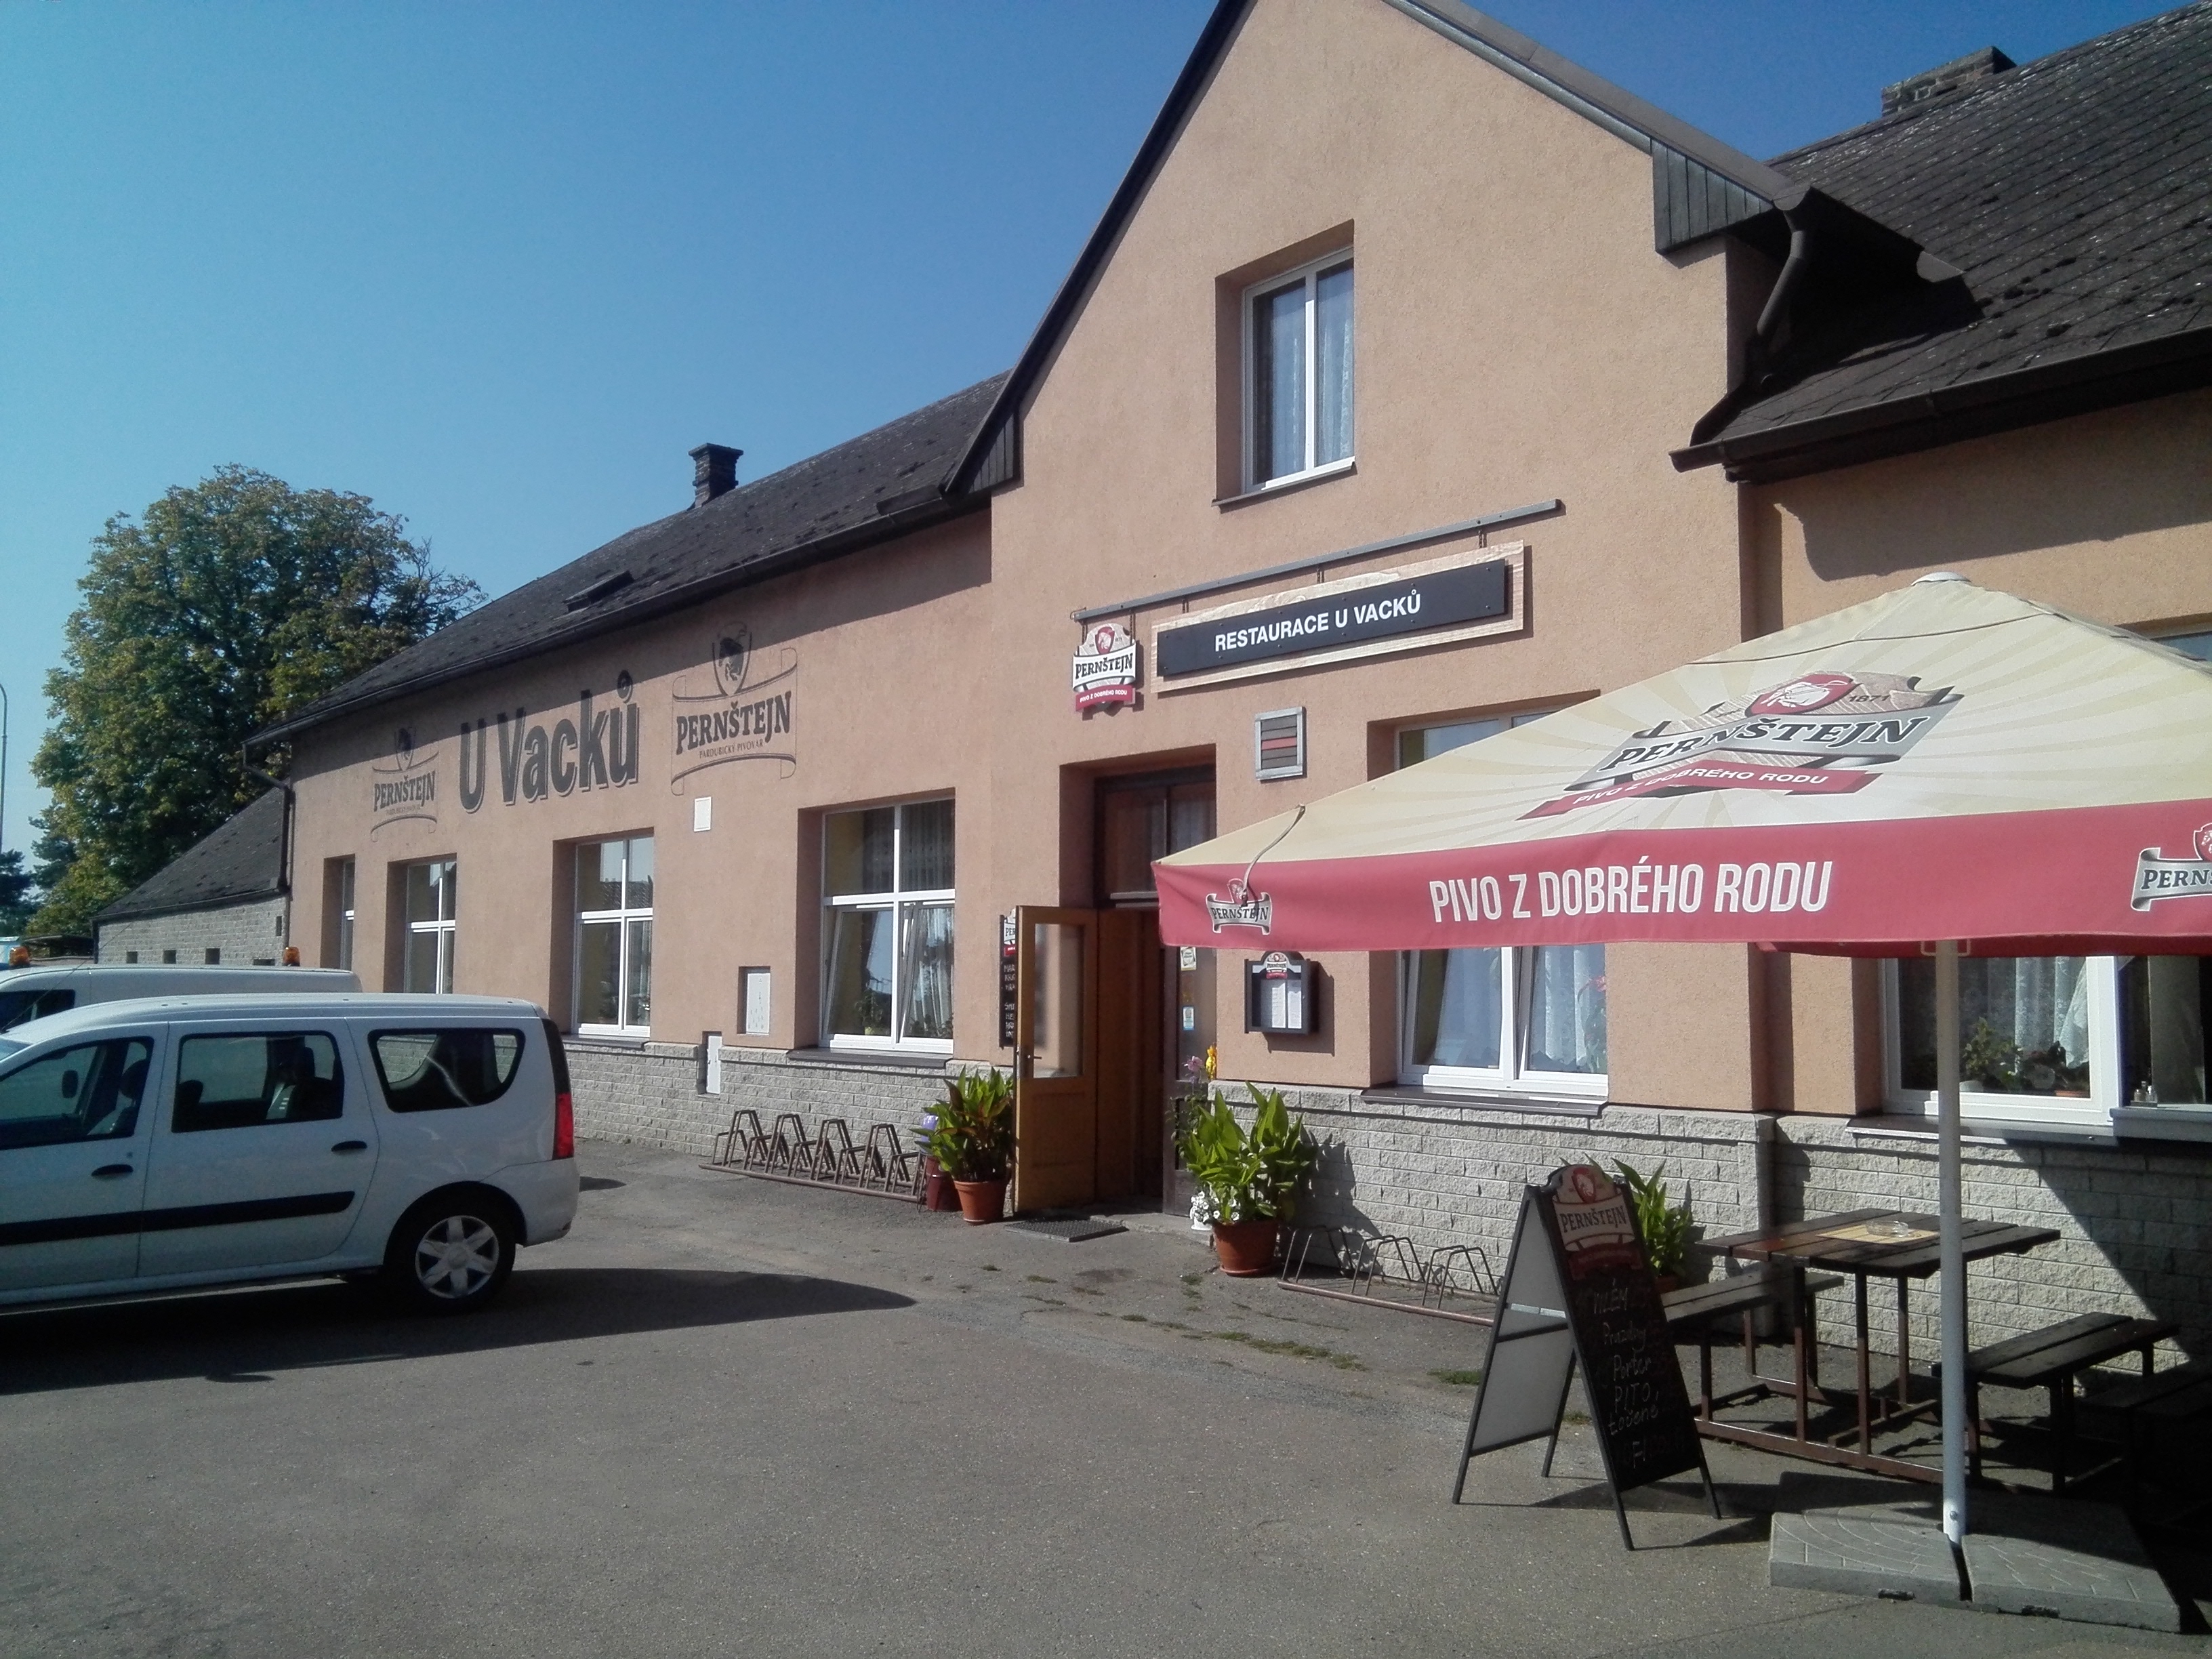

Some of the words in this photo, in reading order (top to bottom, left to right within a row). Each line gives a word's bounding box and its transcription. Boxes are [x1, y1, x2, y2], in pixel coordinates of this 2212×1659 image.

[1215, 613, 1329, 652] RESTAURACE
[1335, 609, 1348, 628] U
[1353, 589, 1420, 624] VACKŮ
[1075, 653, 1133, 679] PERNŠTEJN
[459, 718, 487, 814] U
[497, 670, 640, 806] Vacků
[676, 691, 792, 755] PERNŠTEJN
[1597, 716, 1931, 772] PERNŠTEJN
[373, 770, 436, 812] PERNŠTEJN
[1573, 787, 1621, 804] PIVO
[1625, 781, 1645, 792] Z
[1643, 768, 1754, 787] DOBRÉHO
[1759, 773, 1829, 785] RODU
[1429, 876, 1502, 922] PIVO
[1508, 874, 1531, 918] Z
[1538, 855, 1703, 917] DOBRÉHO
[1714, 861, 1832, 913] RODU
[2140, 869, 2212, 890] PERN
[1559, 1205, 1627, 1233] PERNŠTEJN
